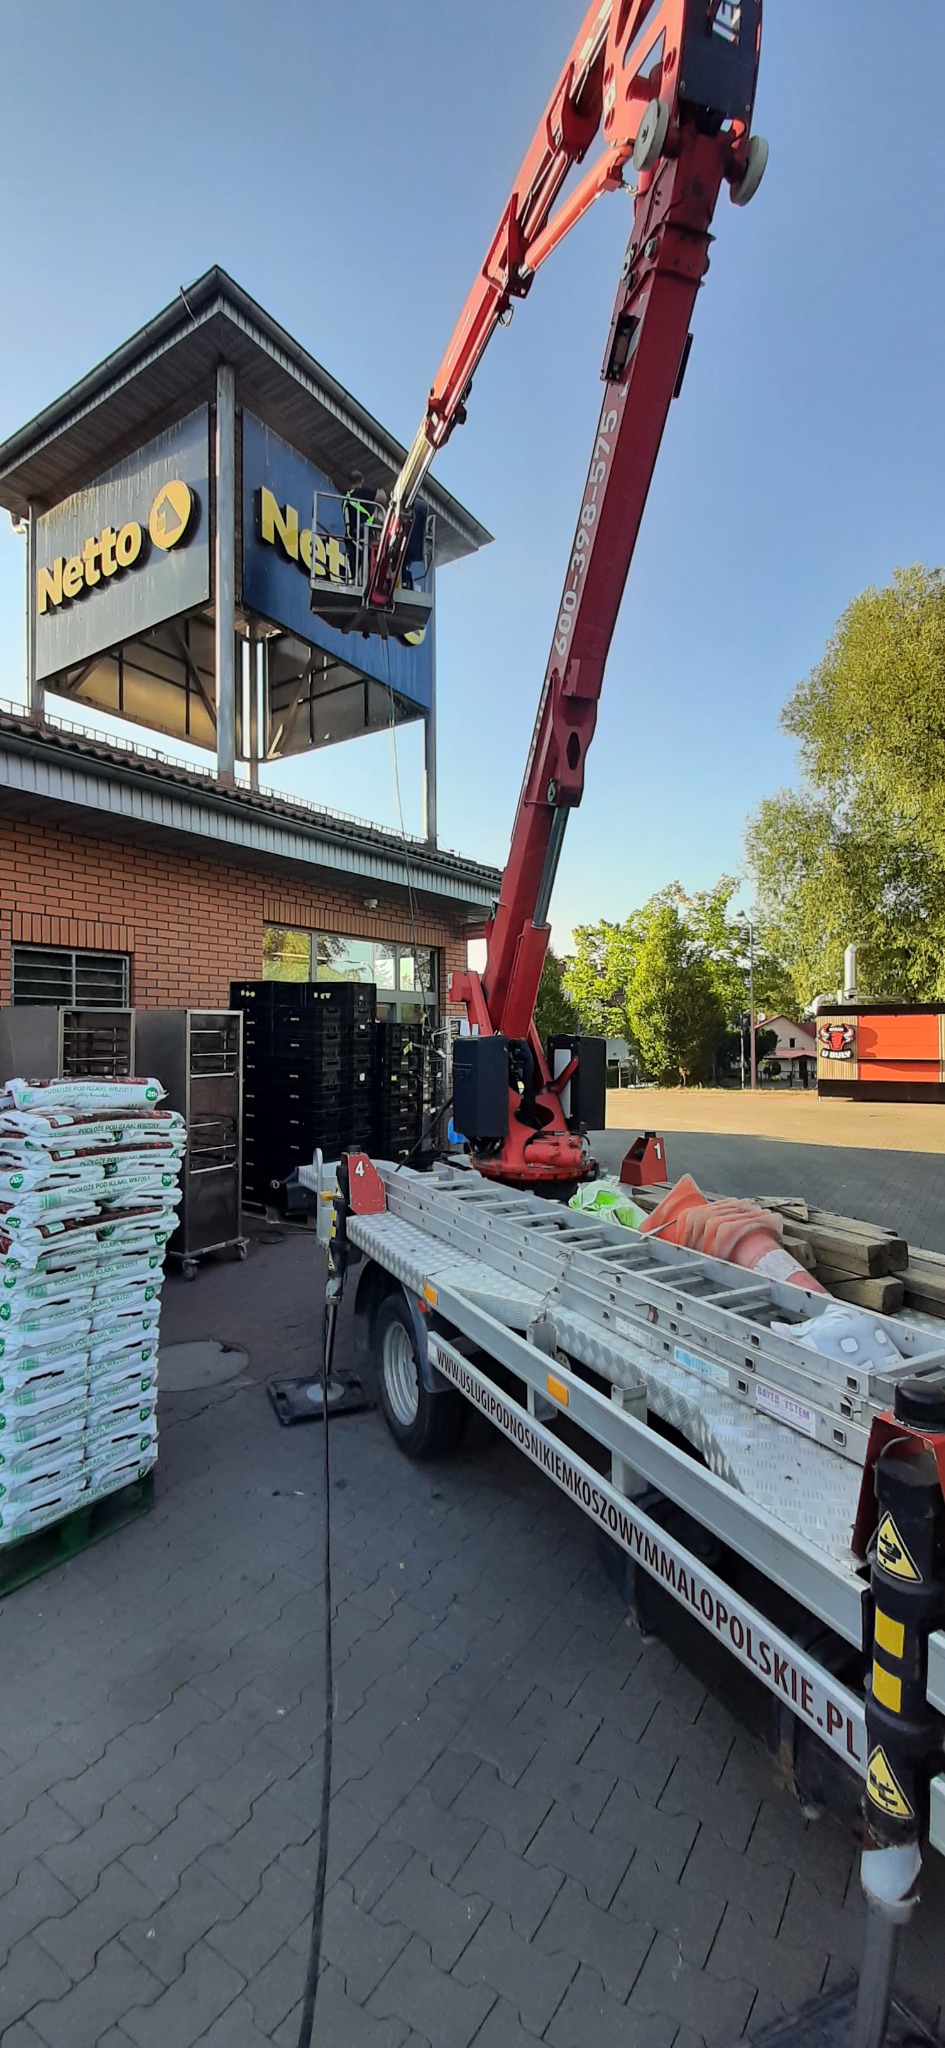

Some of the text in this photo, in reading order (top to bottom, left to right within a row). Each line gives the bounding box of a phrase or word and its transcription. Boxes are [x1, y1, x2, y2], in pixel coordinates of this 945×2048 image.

[37, 521, 142, 615] Netto
[261, 485, 353, 585] Net
[553, 408, 619, 656] 600-398-575
[354, 1160, 366, 1177] 4
[653, 1142, 662, 1160] 1
[757, 1385, 780, 1405] BAYER
[436, 1346, 861, 1763] WWW.USLUGIPODNOSNIKIEMKOSZOWYMMALOPOLSKIE.PL
